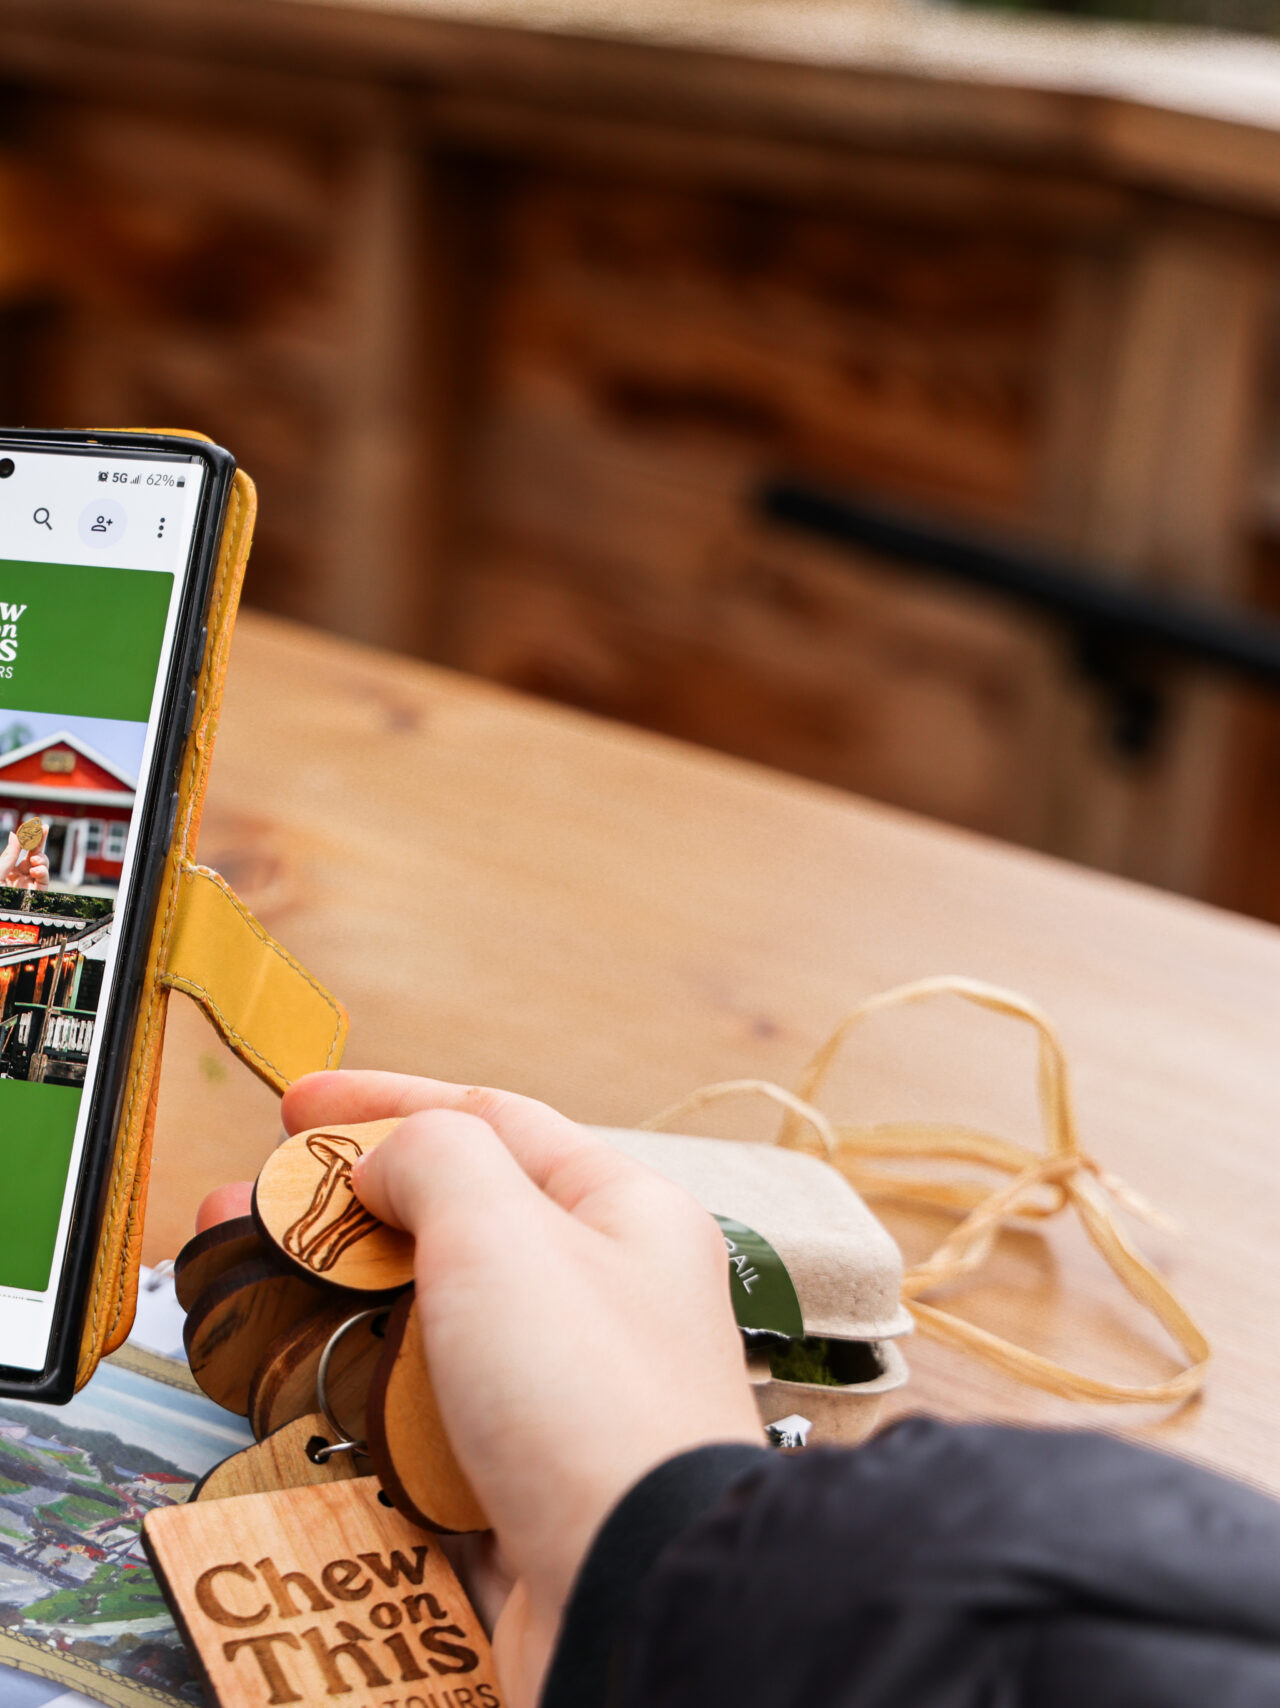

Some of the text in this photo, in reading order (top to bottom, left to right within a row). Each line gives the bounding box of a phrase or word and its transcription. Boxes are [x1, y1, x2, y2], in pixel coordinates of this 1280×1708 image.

[112, 472, 175, 487] 5G 62%
[195, 1545, 429, 1628] Chew
[369, 1592, 447, 1629] on
[222, 1625, 479, 1706] This
[381, 1683, 500, 1708] URS
